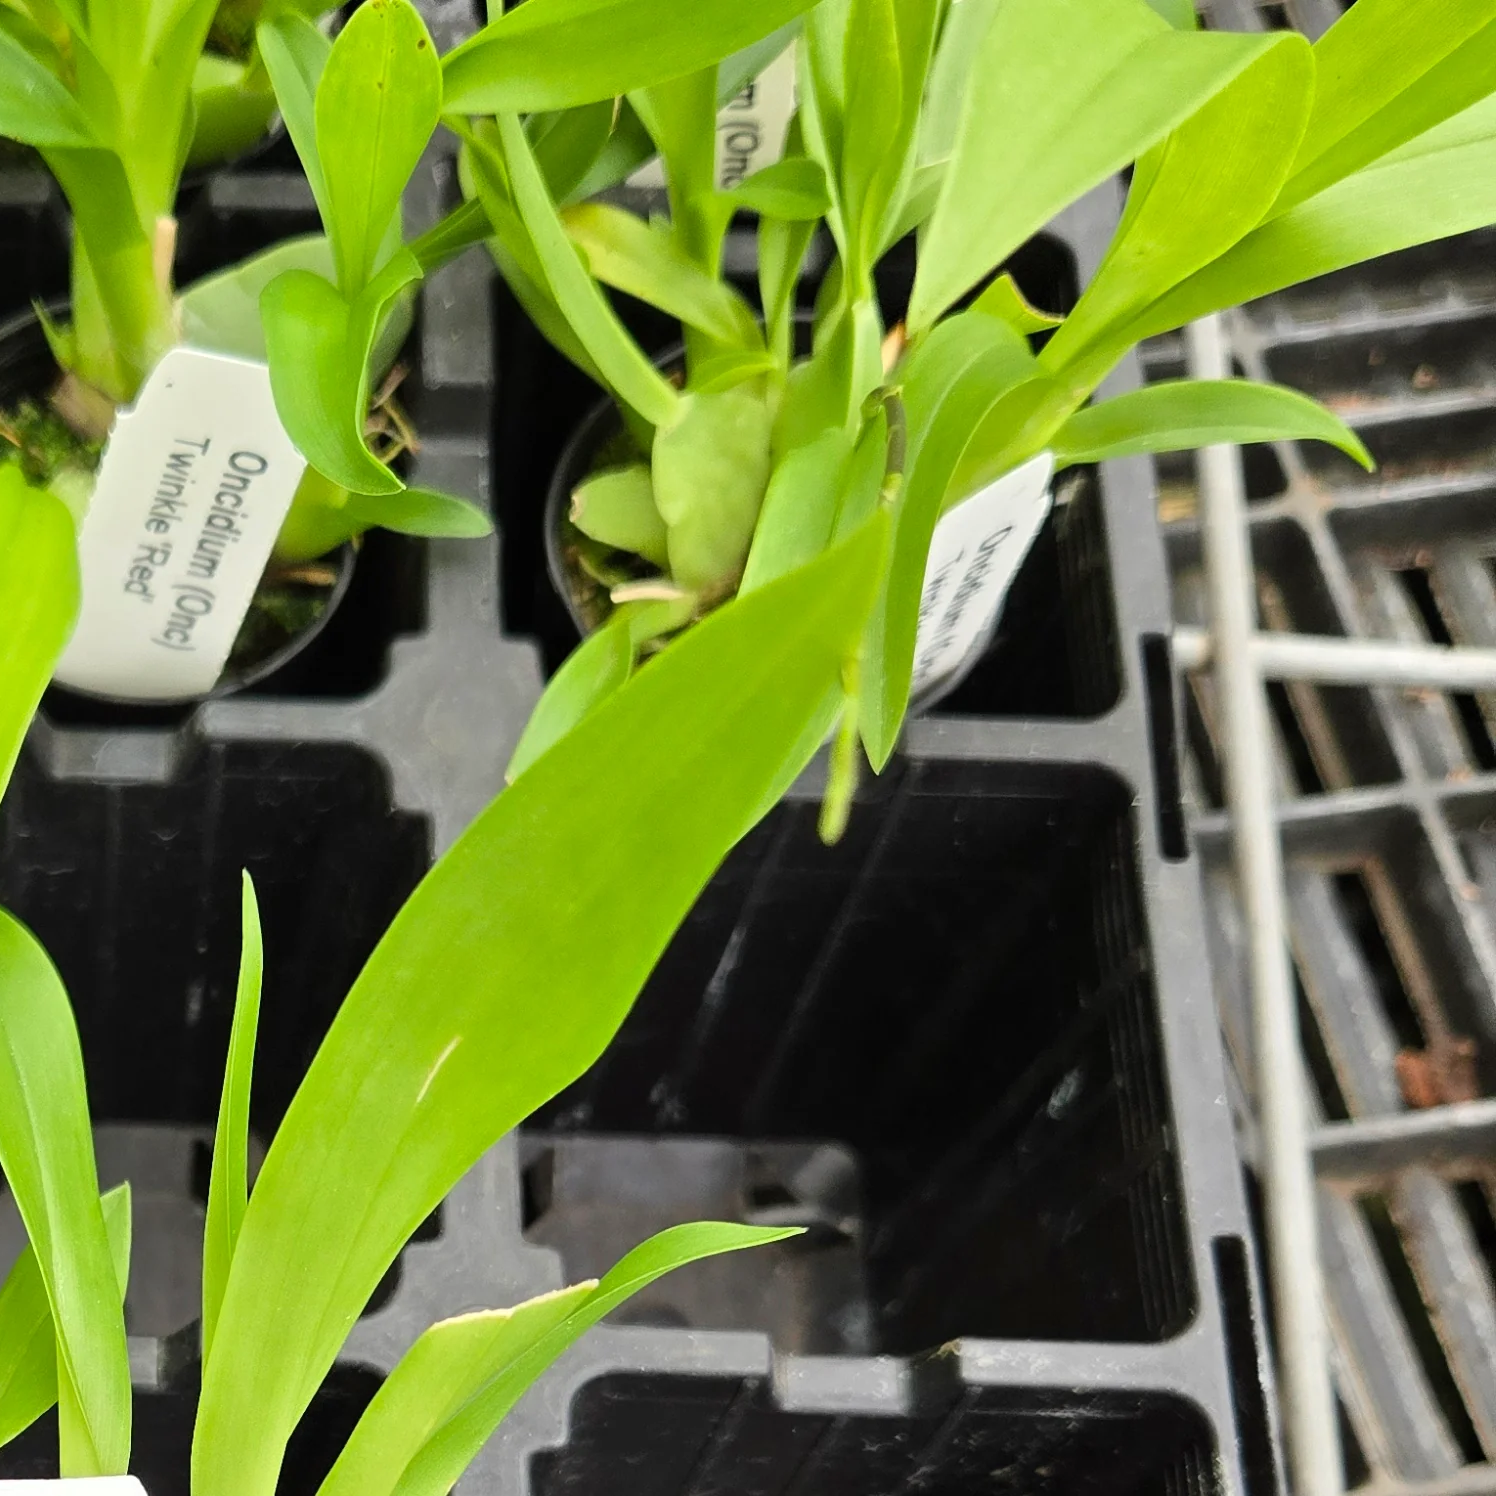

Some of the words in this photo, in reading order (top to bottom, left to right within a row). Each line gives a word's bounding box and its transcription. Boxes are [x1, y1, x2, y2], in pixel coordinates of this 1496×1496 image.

[144, 437, 211, 536] Twinkle
[187, 450, 268, 579] Oncidium
[151, 583, 216, 652] (Onc)
